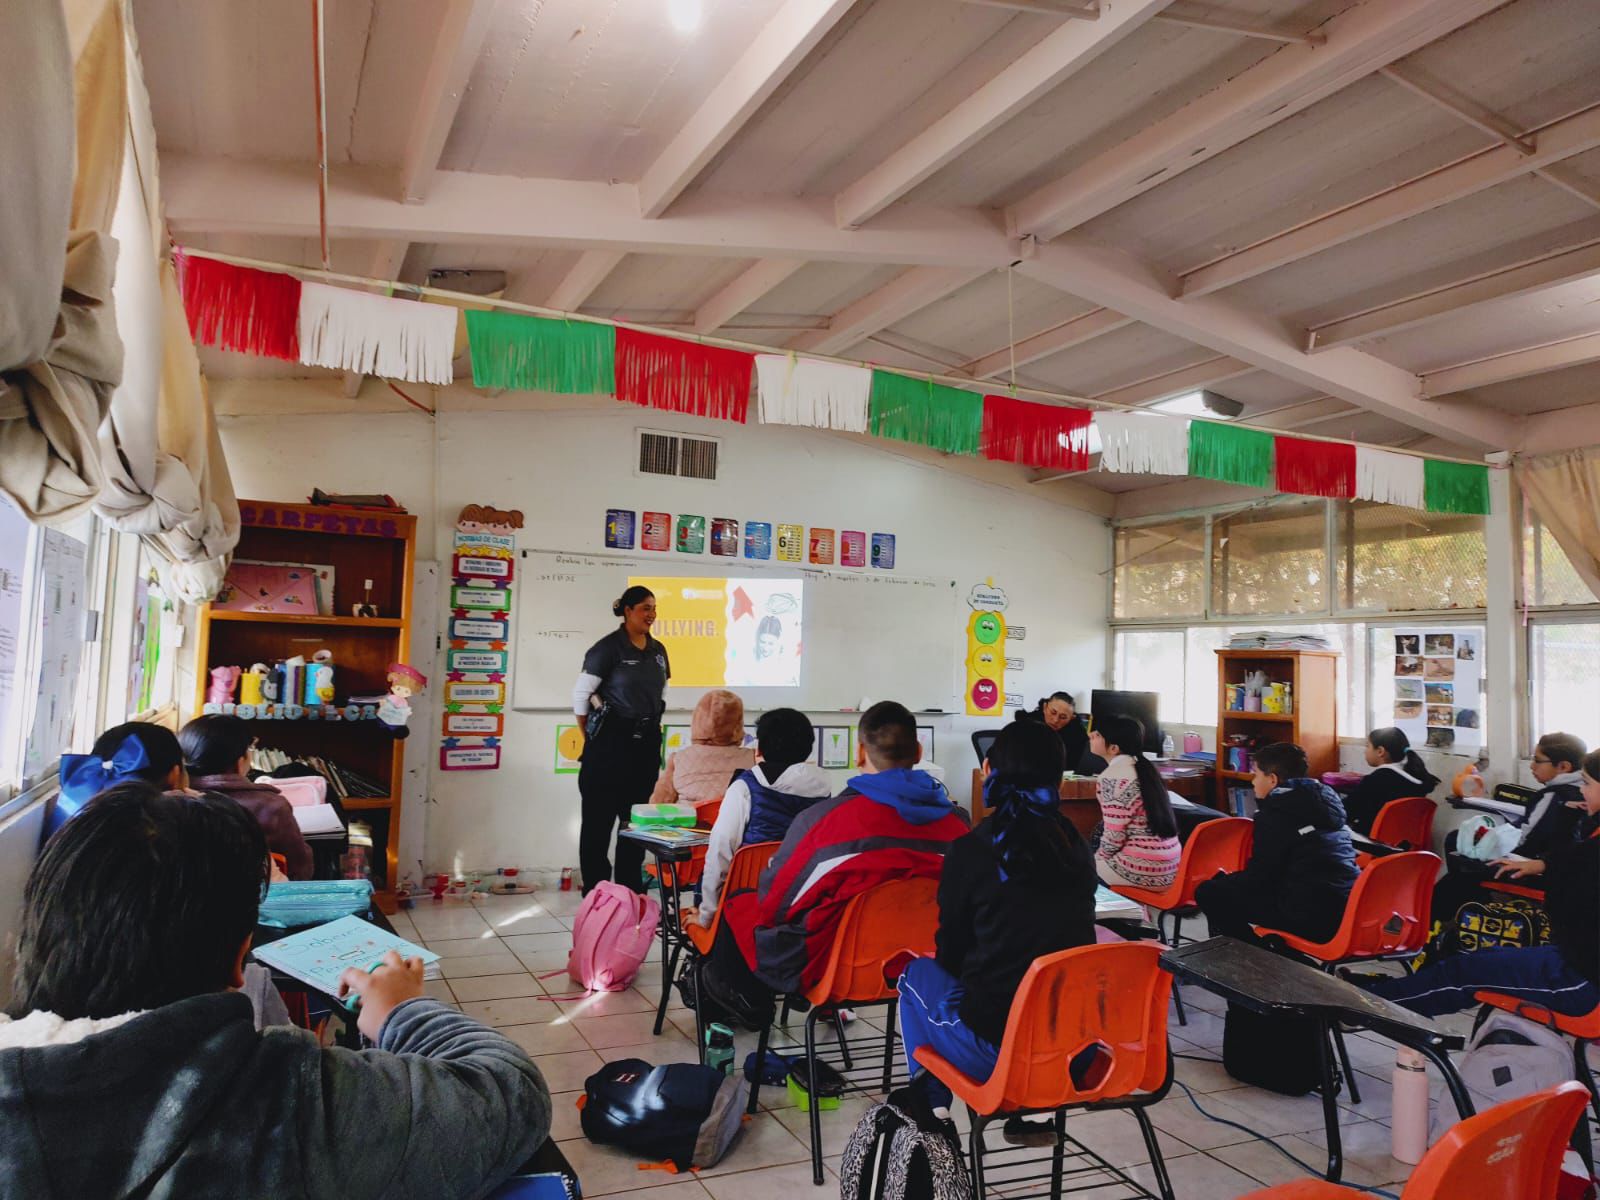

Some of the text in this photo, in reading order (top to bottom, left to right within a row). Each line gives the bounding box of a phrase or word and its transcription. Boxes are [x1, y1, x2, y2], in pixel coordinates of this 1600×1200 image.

[240, 505, 398, 537] CARPETAS
[644, 523, 653, 535] 2
[679, 527, 689, 540] 3
[778, 536, 787, 548] 6
[810, 538, 820, 551] 7
[653, 619, 719, 637] ULLYING.
